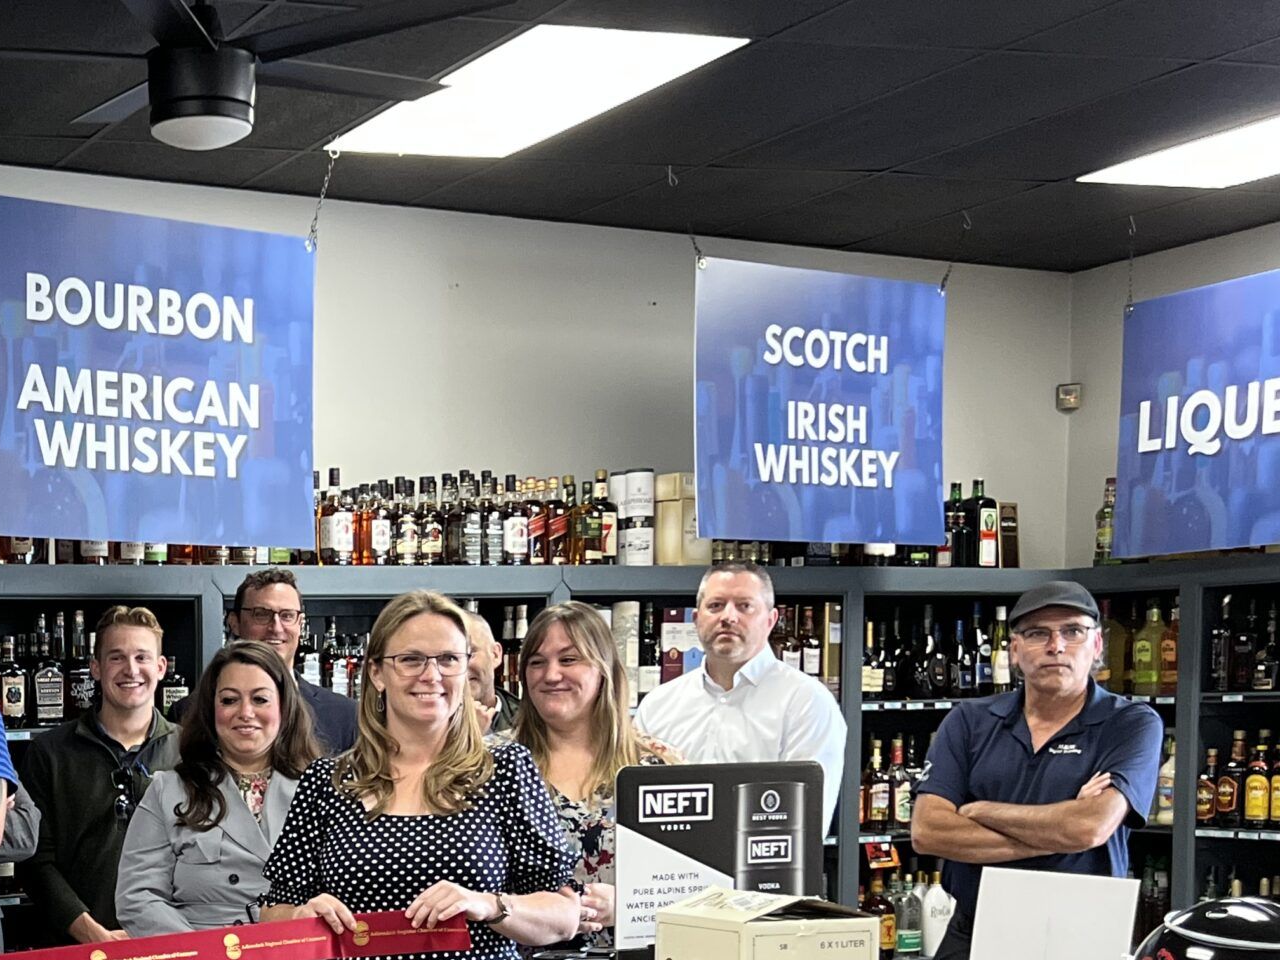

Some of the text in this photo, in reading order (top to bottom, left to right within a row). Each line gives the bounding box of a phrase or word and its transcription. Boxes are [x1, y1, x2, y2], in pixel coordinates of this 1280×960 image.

[25, 272, 254, 344] BOURBON
[763, 323, 889, 374] SCOTCH
[17, 363, 260, 430] AMERICAN
[787, 400, 867, 444] IRISH
[33, 418, 248, 478] WHISKEY
[755, 442, 900, 489] WHISKEY
[645, 791, 707, 815] NEFT
[751, 841, 788, 857] NEFT
[677, 872, 699, 880] WITH
[633, 885, 710, 896] PURE ALPINE SPRI
[626, 901, 655, 910] WATER
[631, 915, 656, 923] ANCIE
[820, 941, 825, 949] 6
[827, 941, 832, 949] X
[840, 940, 865, 948] LITER
